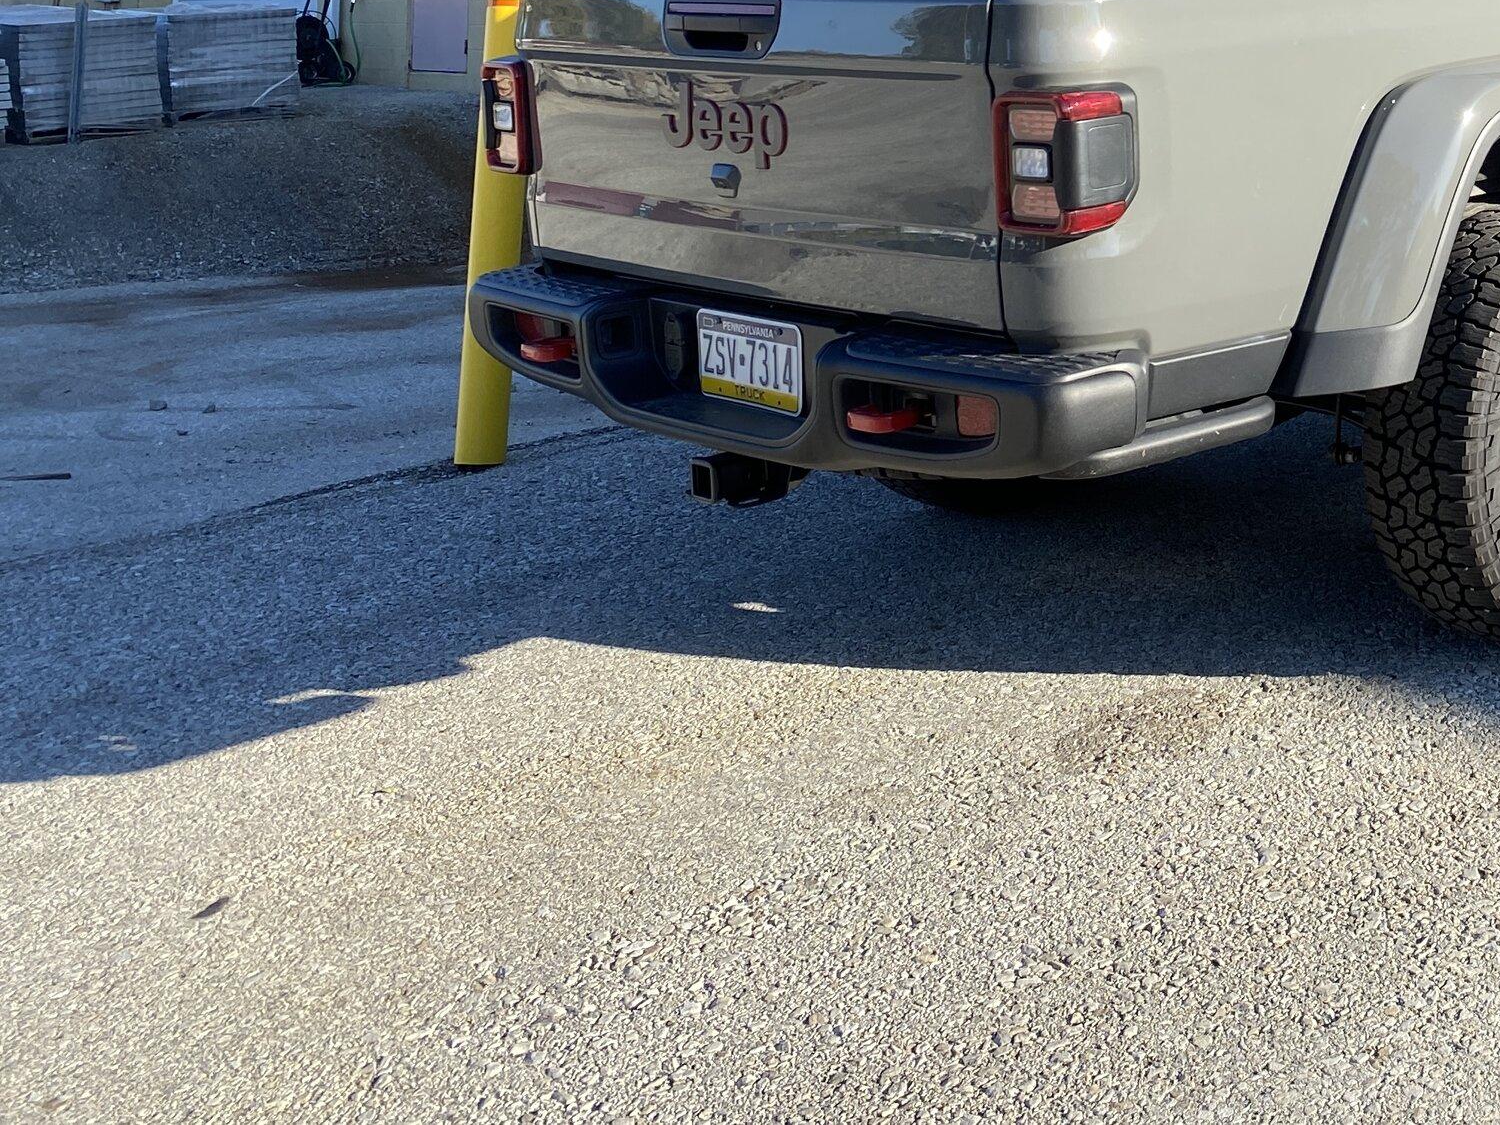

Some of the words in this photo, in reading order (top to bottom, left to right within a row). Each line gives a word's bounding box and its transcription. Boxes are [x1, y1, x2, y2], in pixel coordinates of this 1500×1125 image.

[660, 80, 789, 170] Jeep
[721, 320, 775, 339] PENNSYLVANIA
[734, 384, 766, 402] TRUCK
